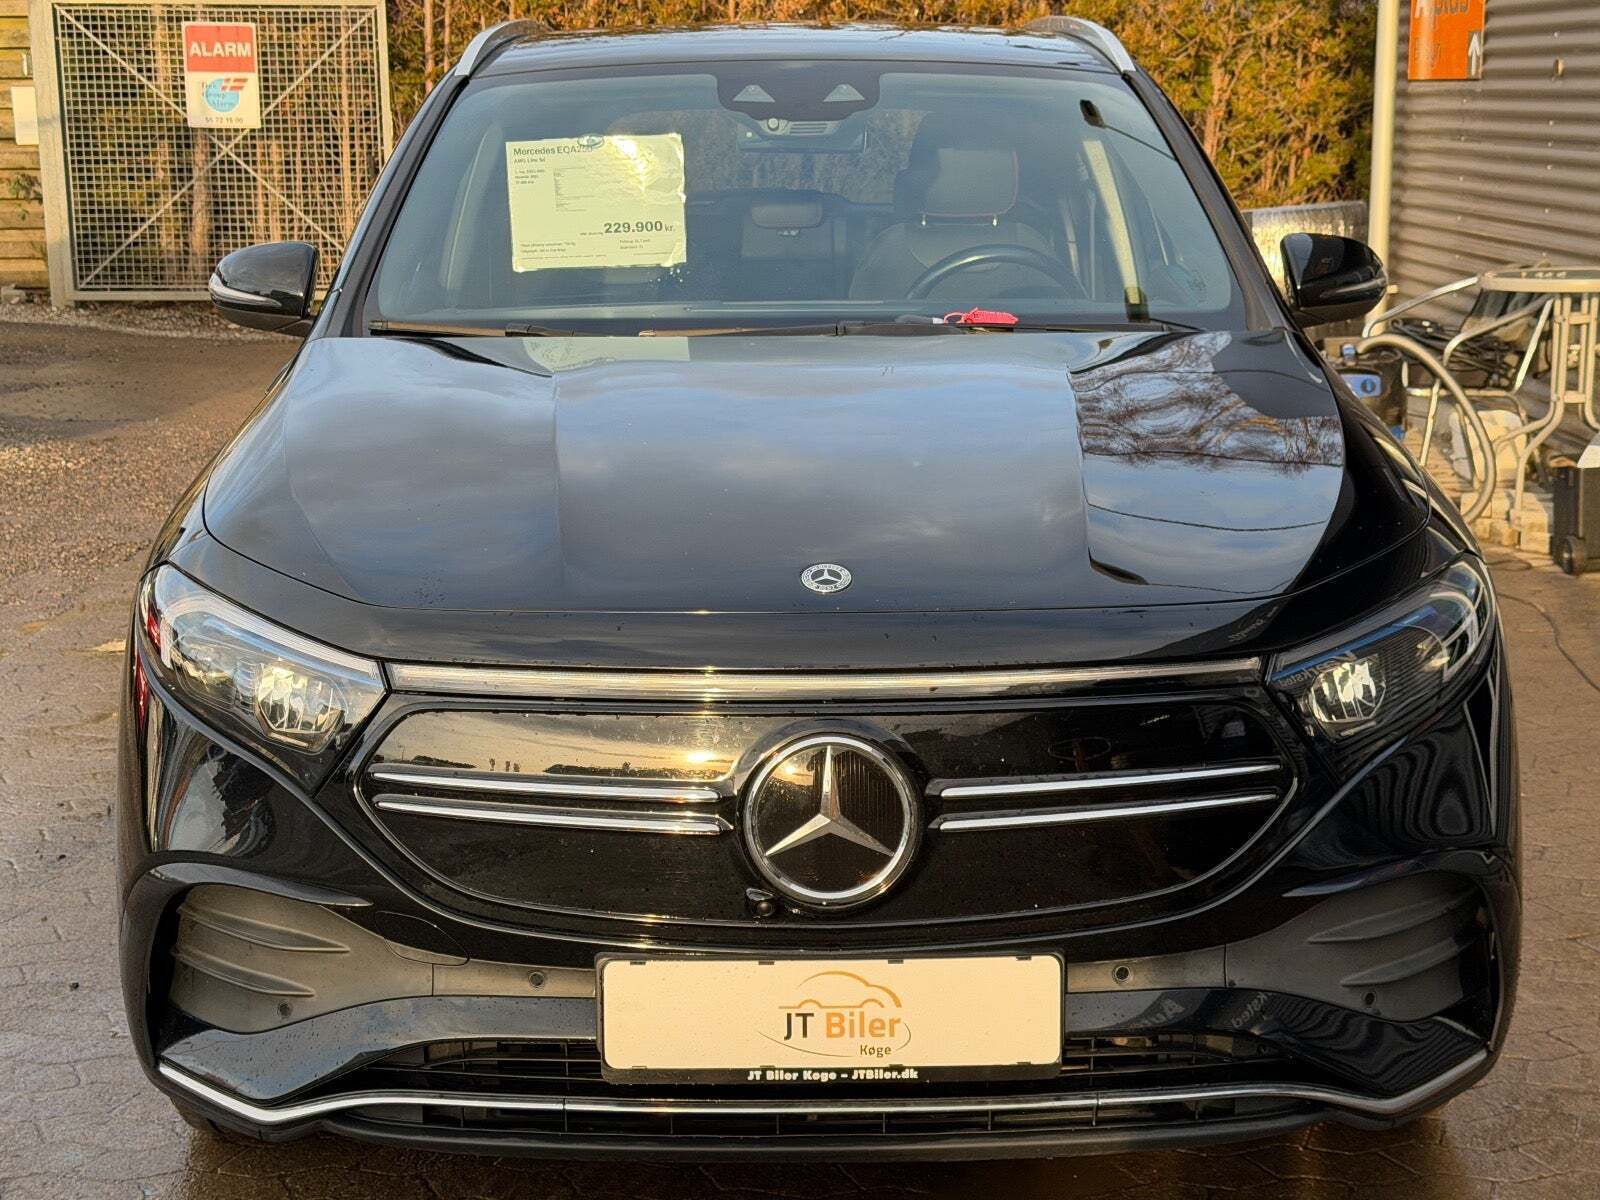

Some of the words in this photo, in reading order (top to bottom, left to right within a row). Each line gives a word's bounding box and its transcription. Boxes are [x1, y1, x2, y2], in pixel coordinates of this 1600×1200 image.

[190, 42, 251, 57] ALARM
[513, 147, 555, 156] Mercedes
[604, 220, 663, 233] 229.900
[784, 1012, 815, 1041] JT
[826, 1011, 901, 1038] Biler
[860, 1045, 892, 1058] Køge
[747, 1070, 763, 1081] JT
[766, 1070, 799, 1081] Biler
[852, 1068, 919, 1080] JTBiler.dk
